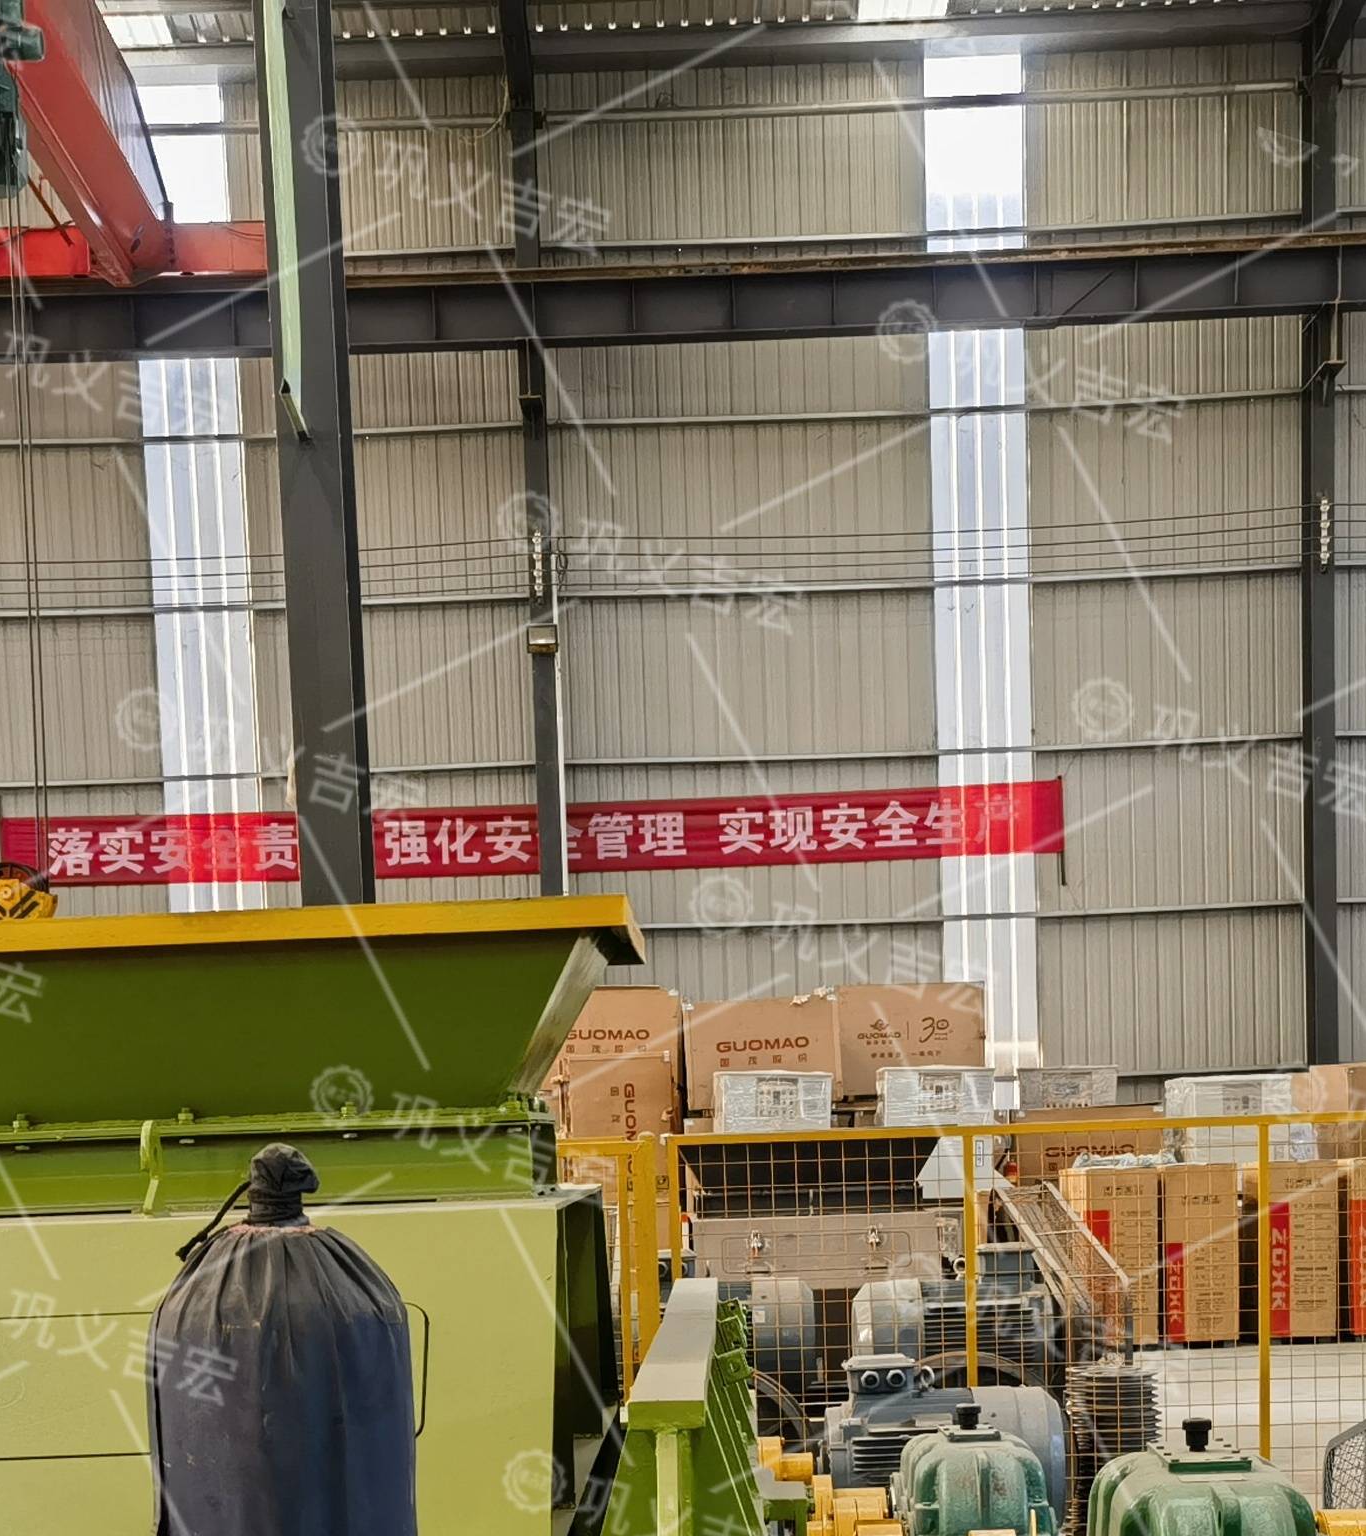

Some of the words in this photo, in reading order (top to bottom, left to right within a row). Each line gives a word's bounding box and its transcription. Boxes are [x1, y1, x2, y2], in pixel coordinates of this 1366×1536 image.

[566, 1029, 650, 1040] GUOMAO
[716, 1036, 810, 1053] GUOMAO
[1045, 1143, 1135, 1158] GUOMAO
